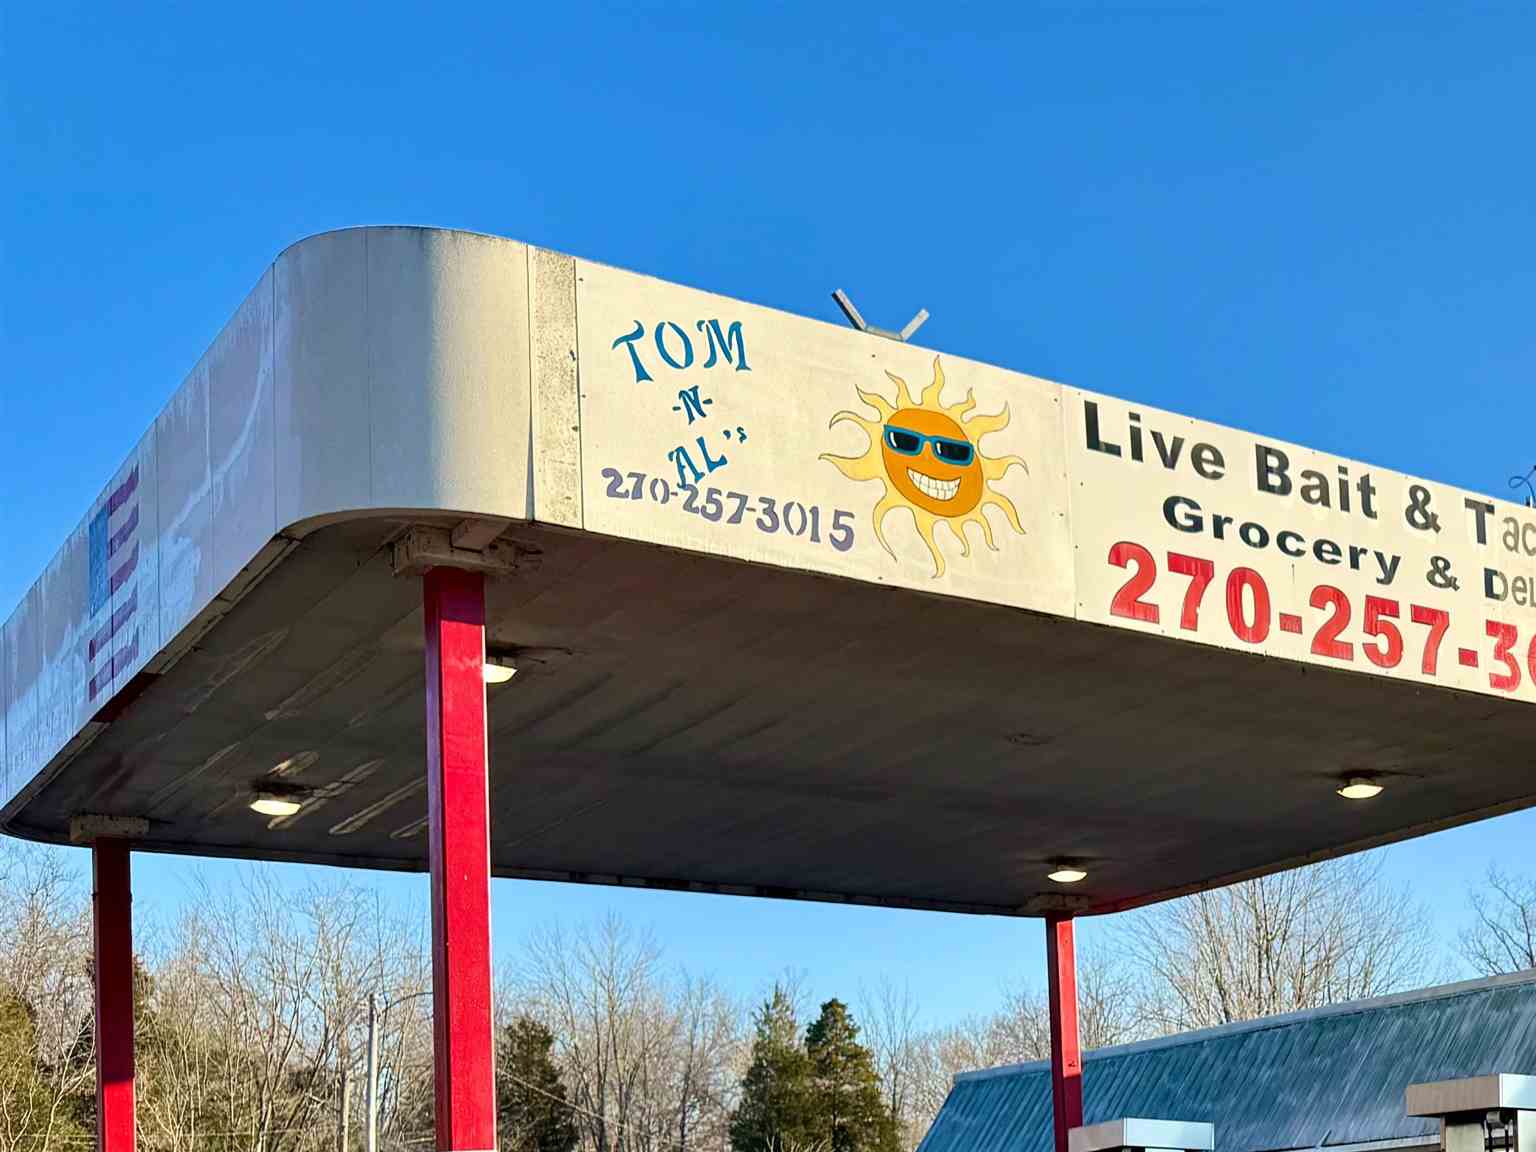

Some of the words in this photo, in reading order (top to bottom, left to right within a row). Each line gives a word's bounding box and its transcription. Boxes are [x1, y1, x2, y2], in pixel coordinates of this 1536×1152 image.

[612, 319, 752, 383] TOM
[601, 467, 856, 552] 270-257-3015
[1084, 399, 1226, 481] Live
[1255, 442, 1379, 520] Bait
[1404, 484, 1441, 534] &
[1162, 494, 1401, 586] Grocery
[1425, 555, 1460, 591] &
